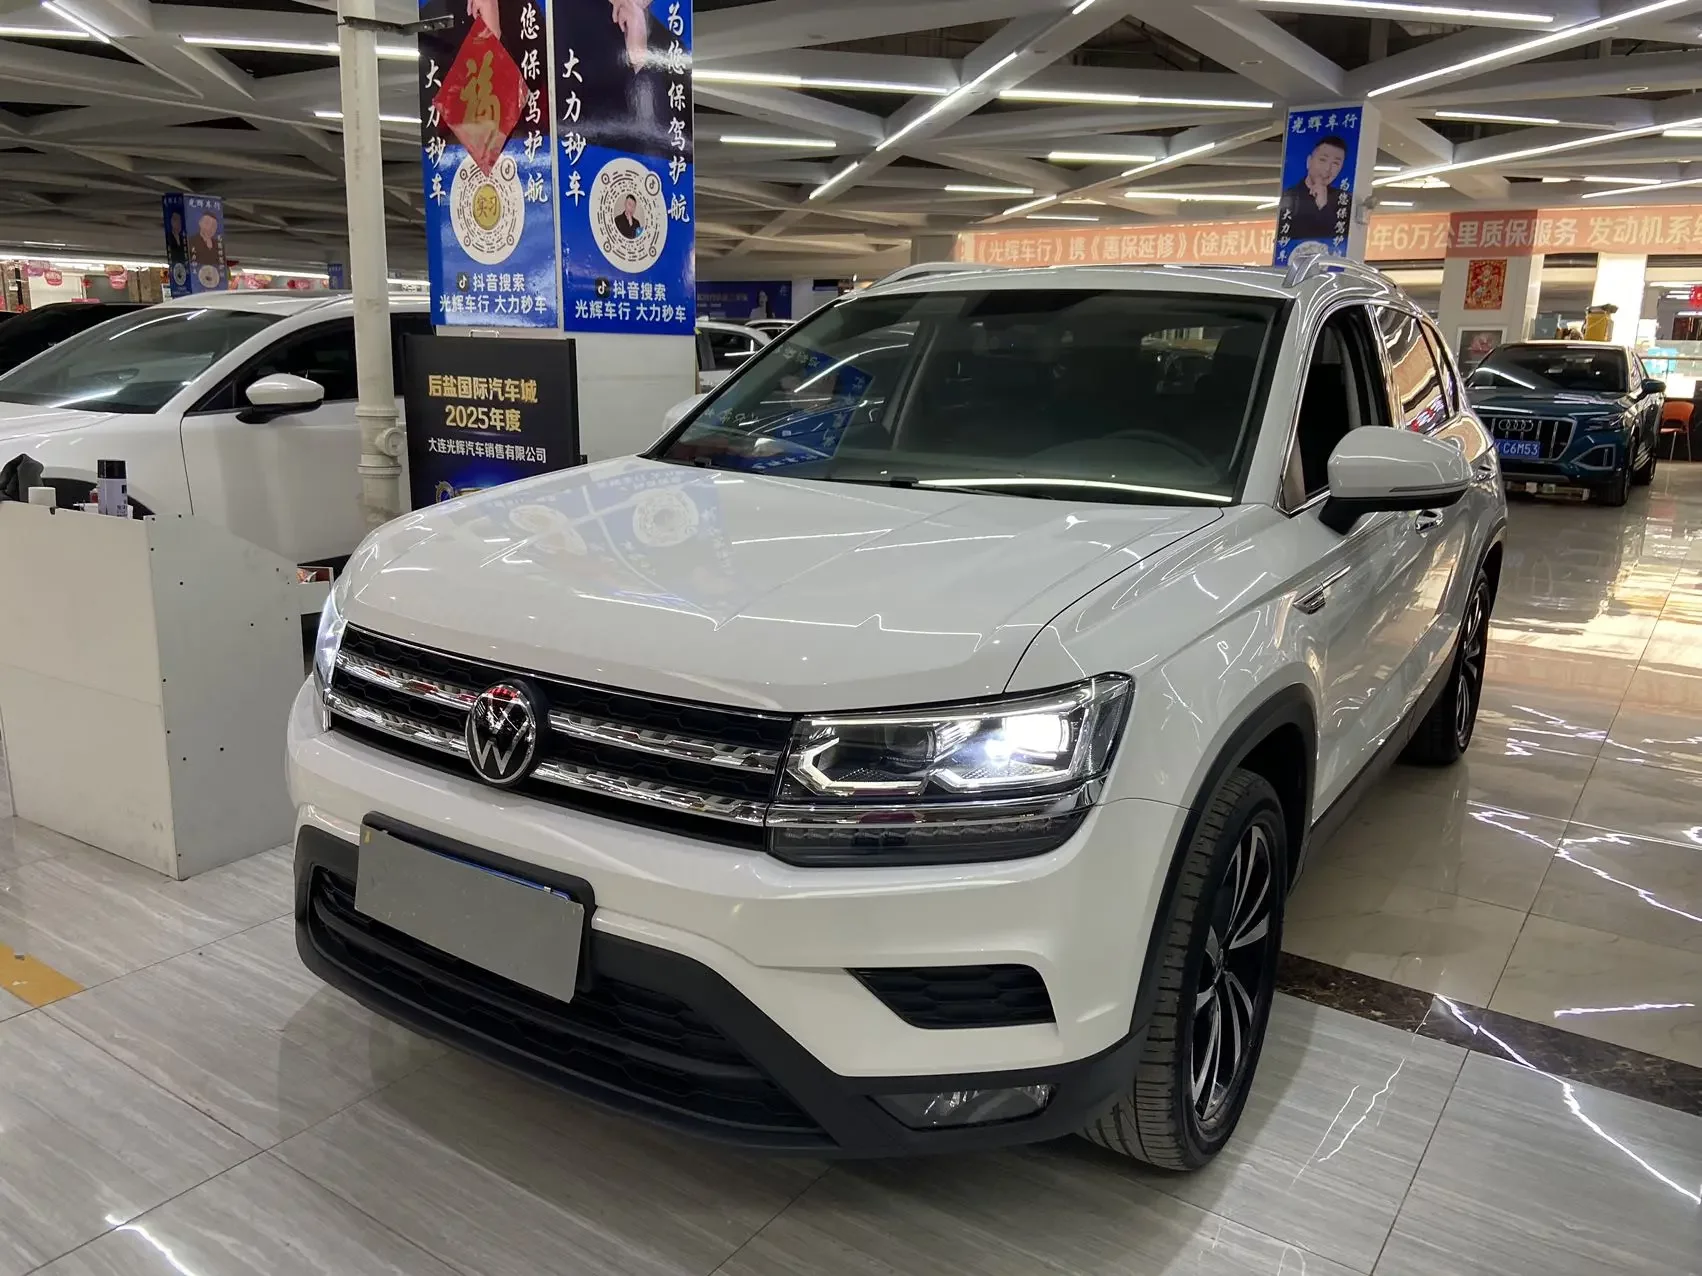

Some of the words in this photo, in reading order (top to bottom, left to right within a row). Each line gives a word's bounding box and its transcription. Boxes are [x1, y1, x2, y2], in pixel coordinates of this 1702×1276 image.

[667, 2, 690, 223] 为您保驾护航
[424, 59, 447, 207] 大力秒车
[561, 48, 588, 207] 大力秒车
[1369, 217, 1578, 252] 年6万公里质保服务
[473, 273, 525, 292] 抖音搜索
[613, 280, 666, 301] 抖音搜索
[440, 294, 489, 313] 光辉车行
[494, 295, 547, 314] 大力秒车
[575, 299, 630, 320] 光辉车行
[636, 303, 686, 322] 大力秒车
[428, 375, 538, 403] 后盐国际汽车城
[445, 405, 522, 432] 2025年度
[428, 437, 547, 463] 大连光辉汽车销售有限公司
